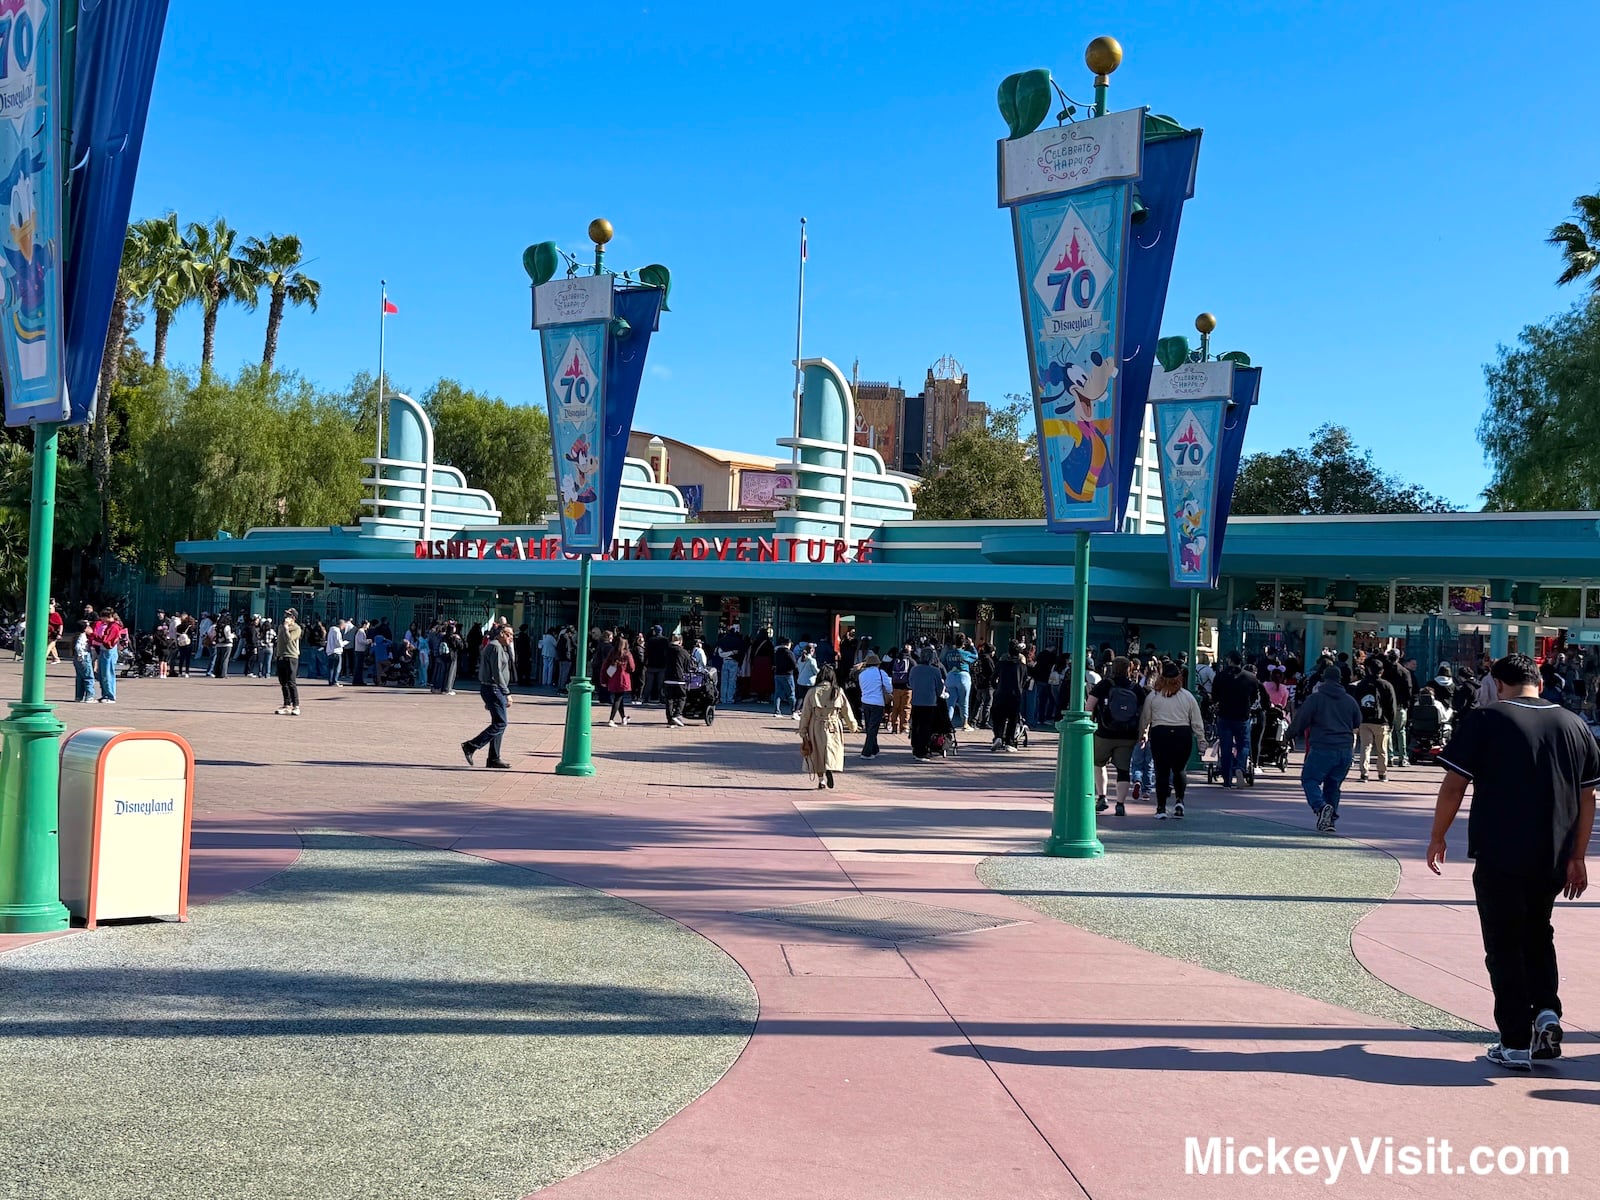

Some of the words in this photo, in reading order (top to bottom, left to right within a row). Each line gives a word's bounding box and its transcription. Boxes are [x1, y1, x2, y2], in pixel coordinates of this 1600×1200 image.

[1044, 143, 1092, 165] CELEBRATE
[1054, 158, 1083, 171] HAPPY
[1047, 269, 1096, 312] 70
[1052, 314, 1093, 333] Disneyland
[560, 376, 590, 404] 70
[1173, 443, 1203, 466] 70
[415, 538, 487, 560] DISNEY
[669, 536, 873, 563] ADVENTURE
[114, 798, 174, 815] Disneyland
